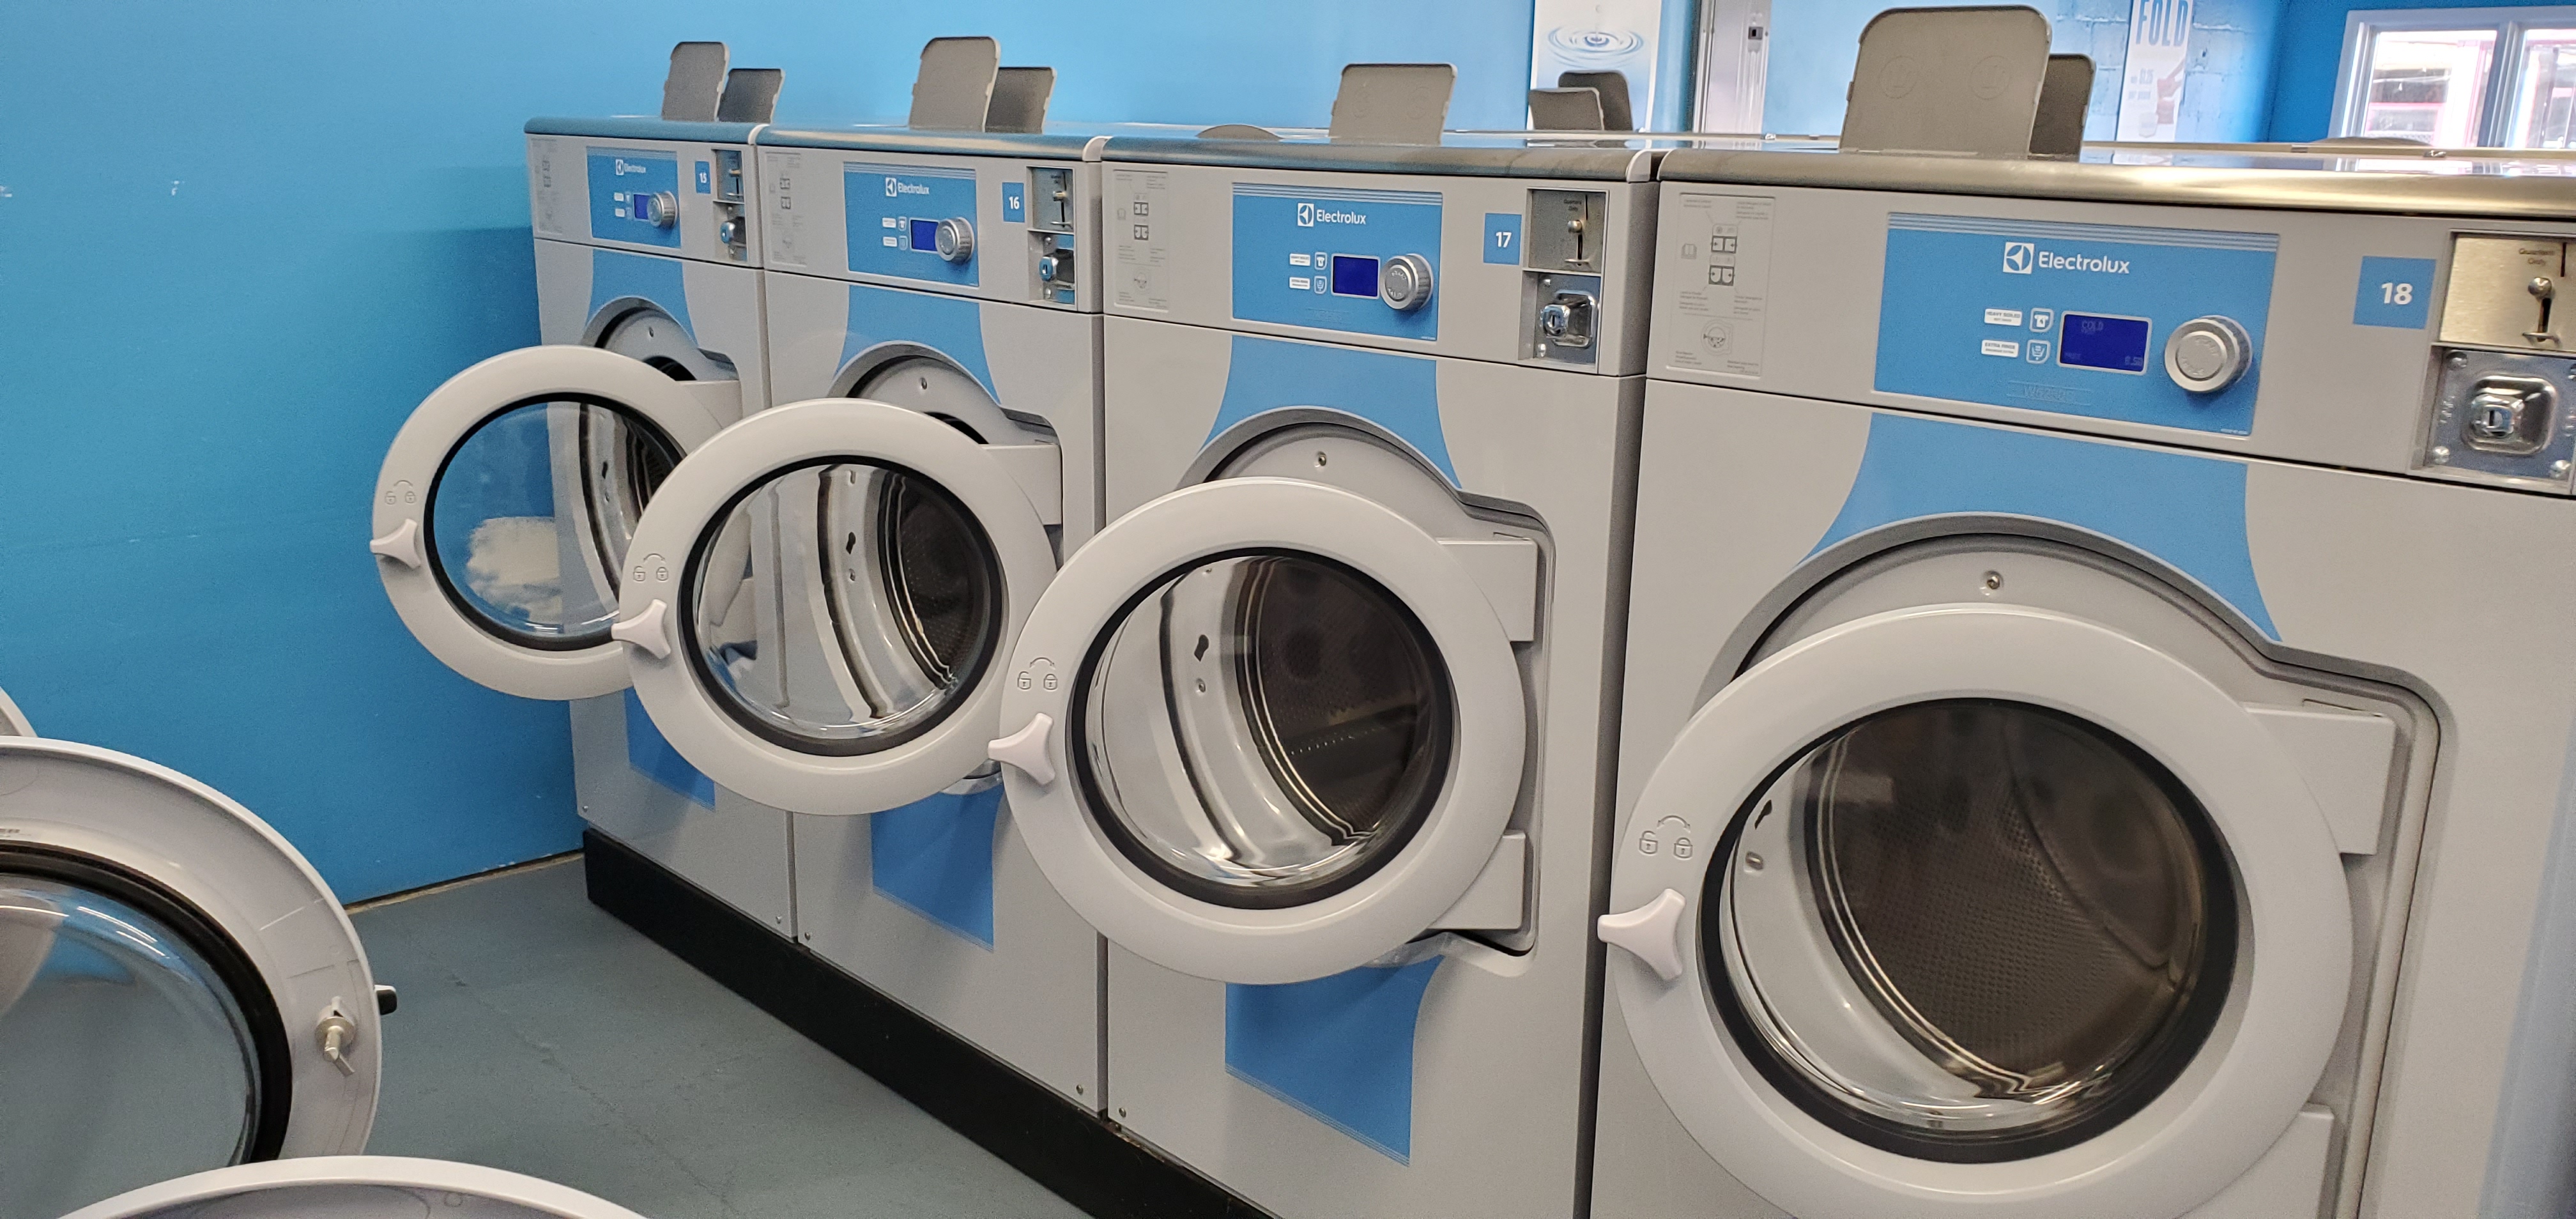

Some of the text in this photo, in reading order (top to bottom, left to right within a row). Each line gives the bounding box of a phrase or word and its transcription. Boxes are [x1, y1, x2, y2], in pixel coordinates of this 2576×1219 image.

[2136, 0, 2189, 47] FOLD
[700, 172, 707, 183] 15
[898, 183, 930, 195] Electrolux
[1009, 196, 1020, 210] 16
[1316, 209, 1367, 225] Electrolux
[1496, 231, 1512, 248] 17
[2038, 251, 2130, 274] Electrolux
[2381, 282, 2413, 305] 18
